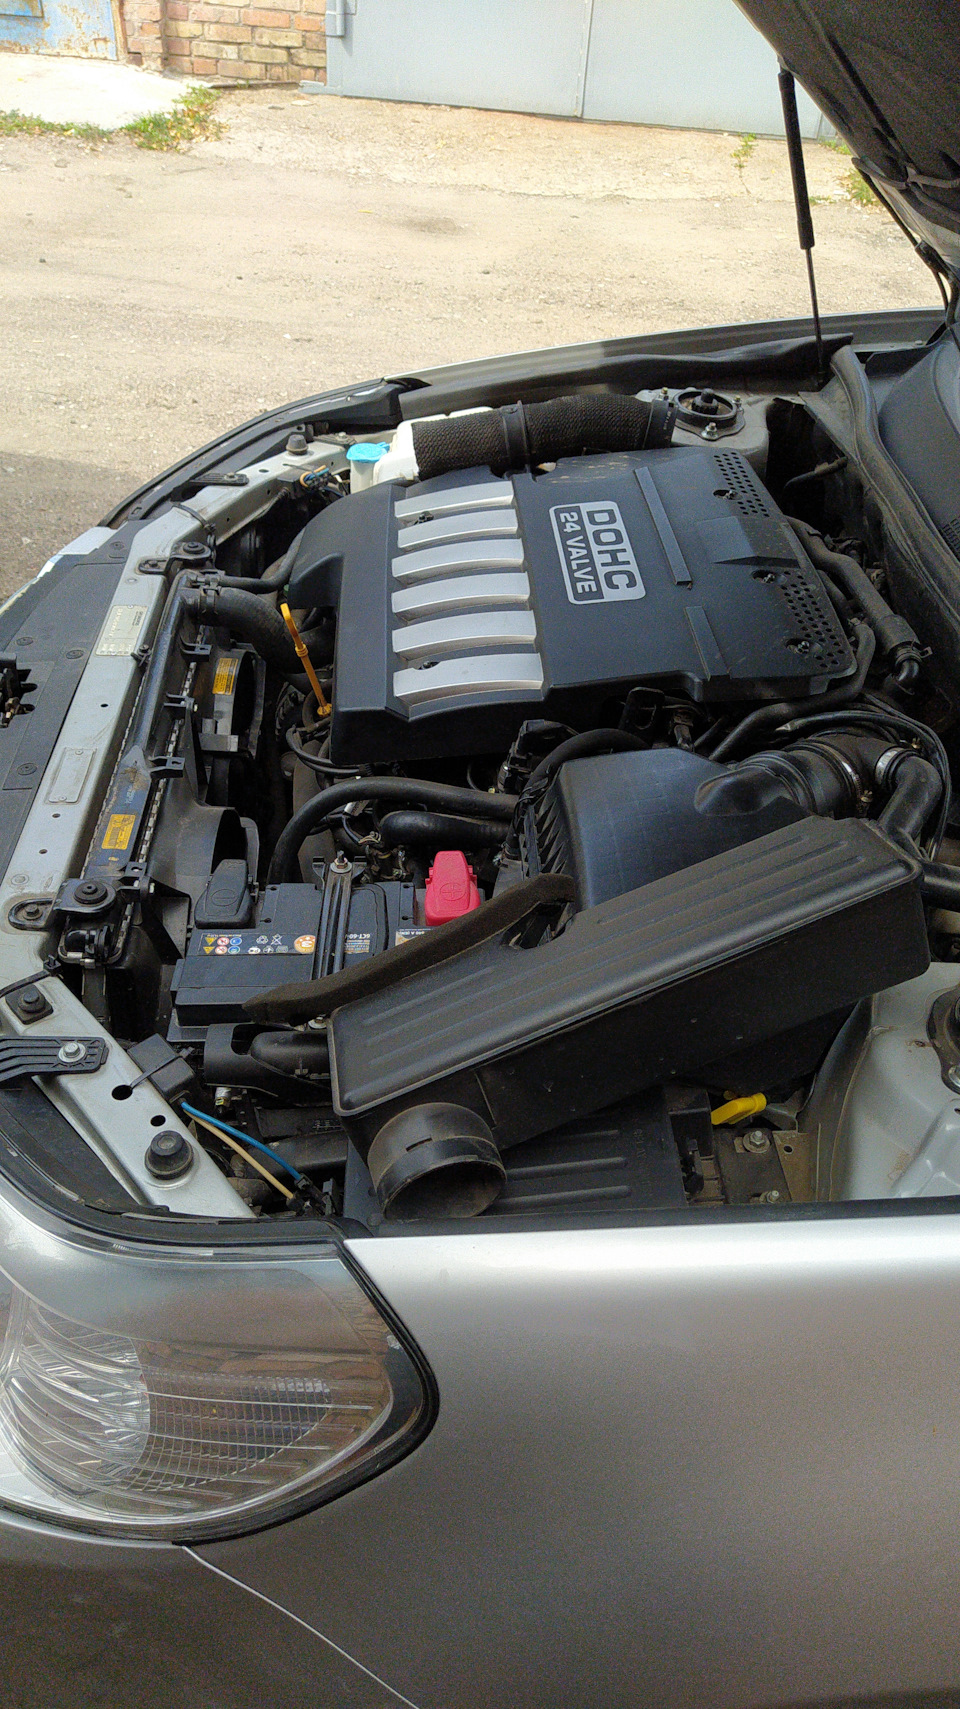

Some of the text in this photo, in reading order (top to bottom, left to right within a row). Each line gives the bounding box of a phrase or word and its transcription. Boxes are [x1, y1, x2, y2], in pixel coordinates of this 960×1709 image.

[559, 511, 598, 594] 24 VALVE
[586, 508, 638, 590] DOHC
